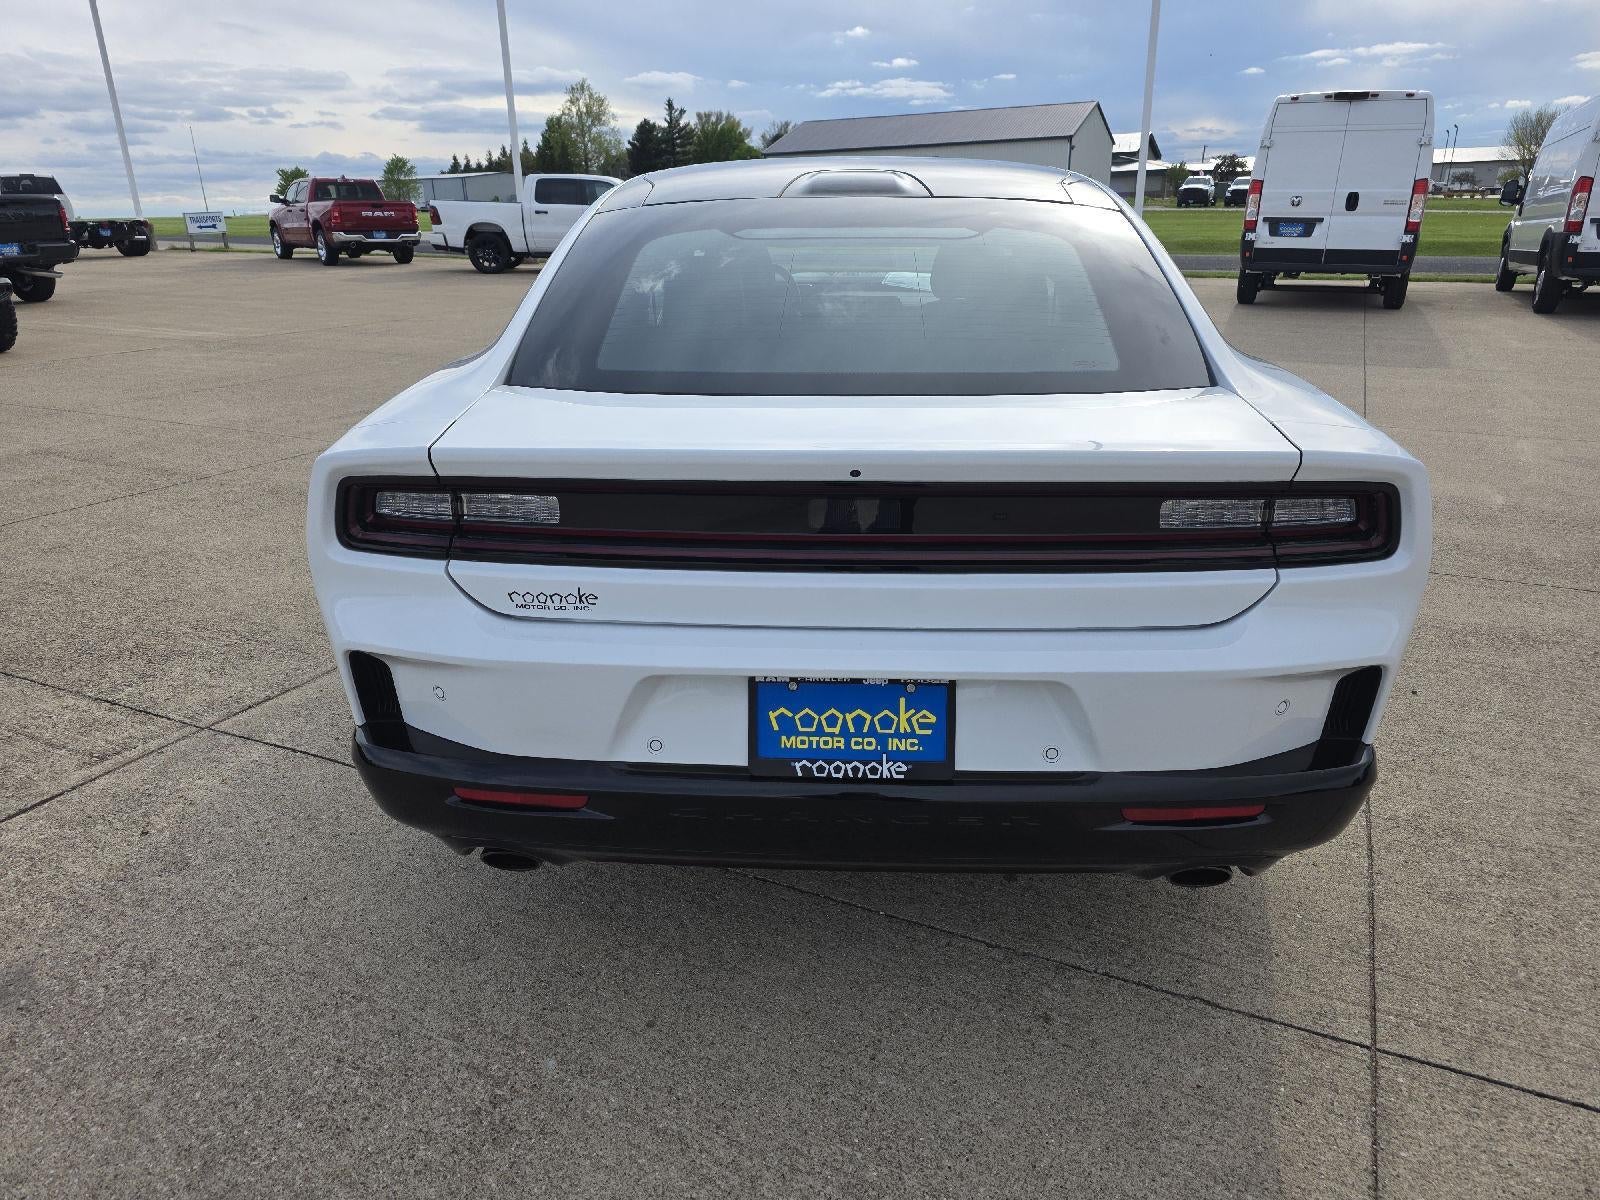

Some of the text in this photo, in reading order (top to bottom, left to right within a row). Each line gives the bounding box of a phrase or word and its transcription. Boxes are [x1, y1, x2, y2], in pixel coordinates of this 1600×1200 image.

[189, 215, 222, 224] TRANSPORTS
[515, 603, 551, 611] MOTOR
[862, 677, 889, 687] Jeep
[768, 697, 937, 735] roanoke
[781, 735, 924, 751] MOTOR CO. INC.
[794, 753, 908, 779] roanoke
